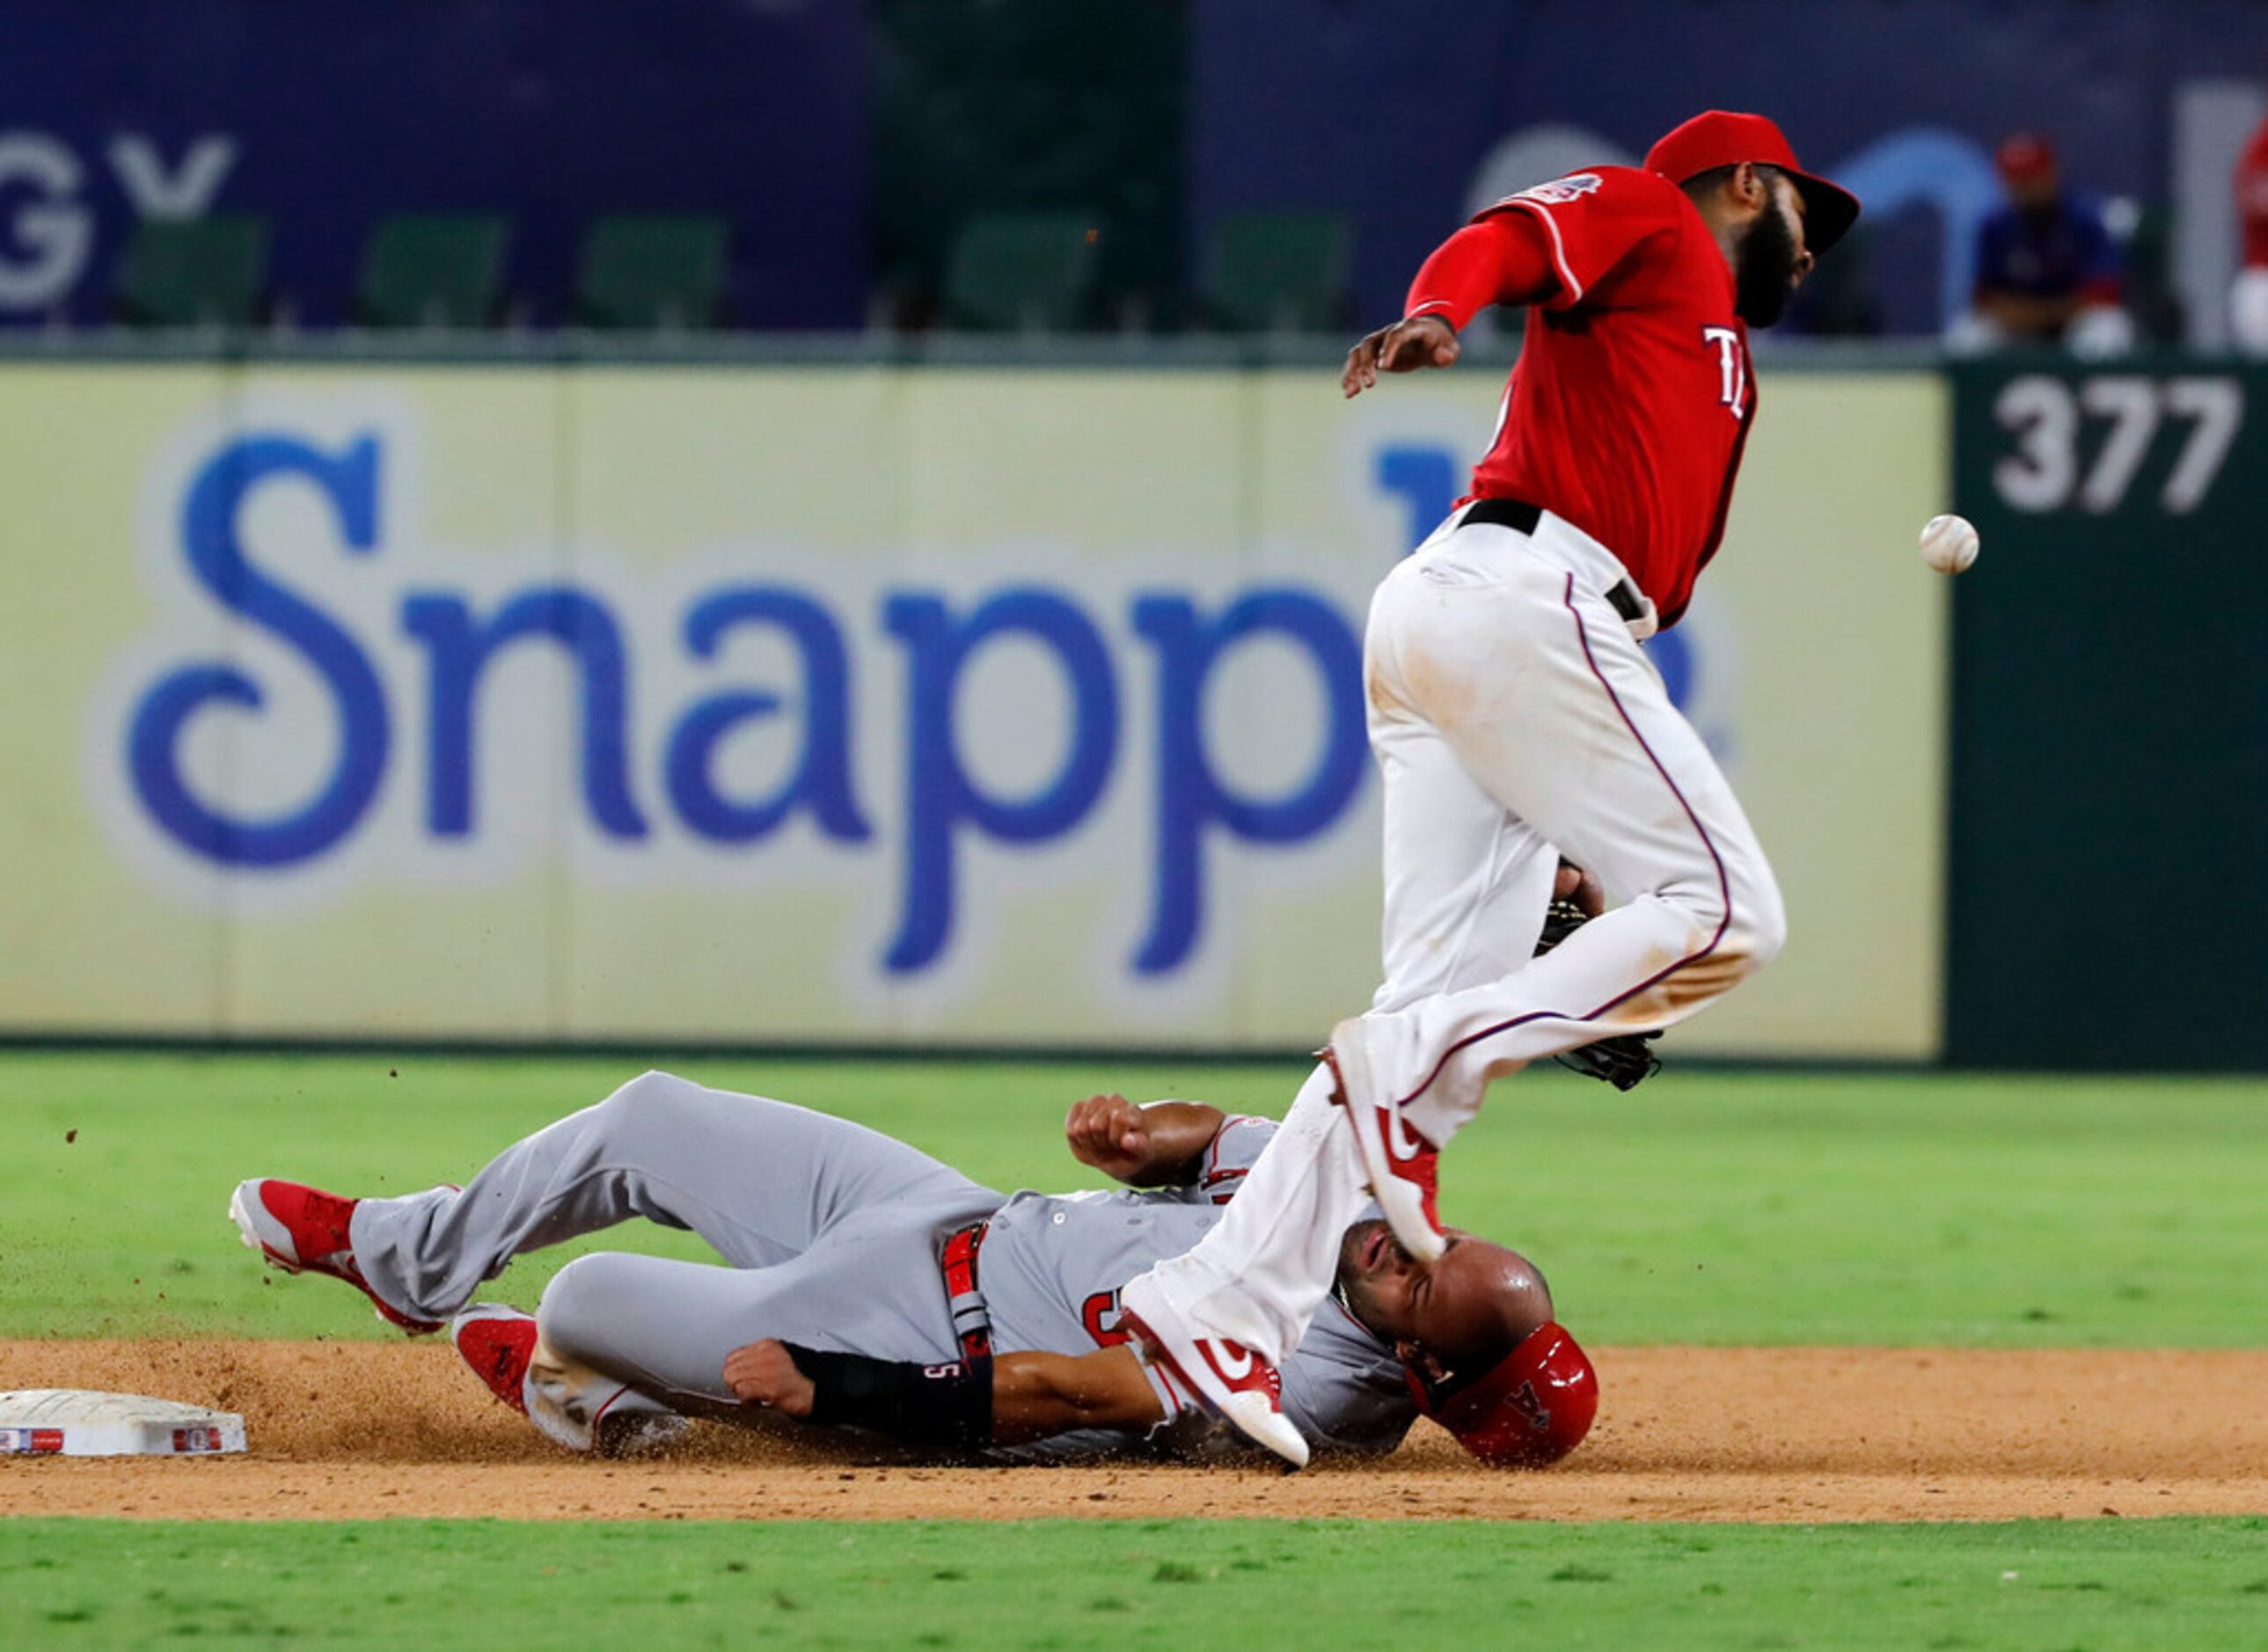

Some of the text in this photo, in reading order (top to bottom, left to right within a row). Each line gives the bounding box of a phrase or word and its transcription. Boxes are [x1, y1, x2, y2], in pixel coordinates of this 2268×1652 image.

[1994, 376, 2243, 514] 377
[124, 429, 1697, 977] Snapp
[923, 1363, 960, 1379] 5
